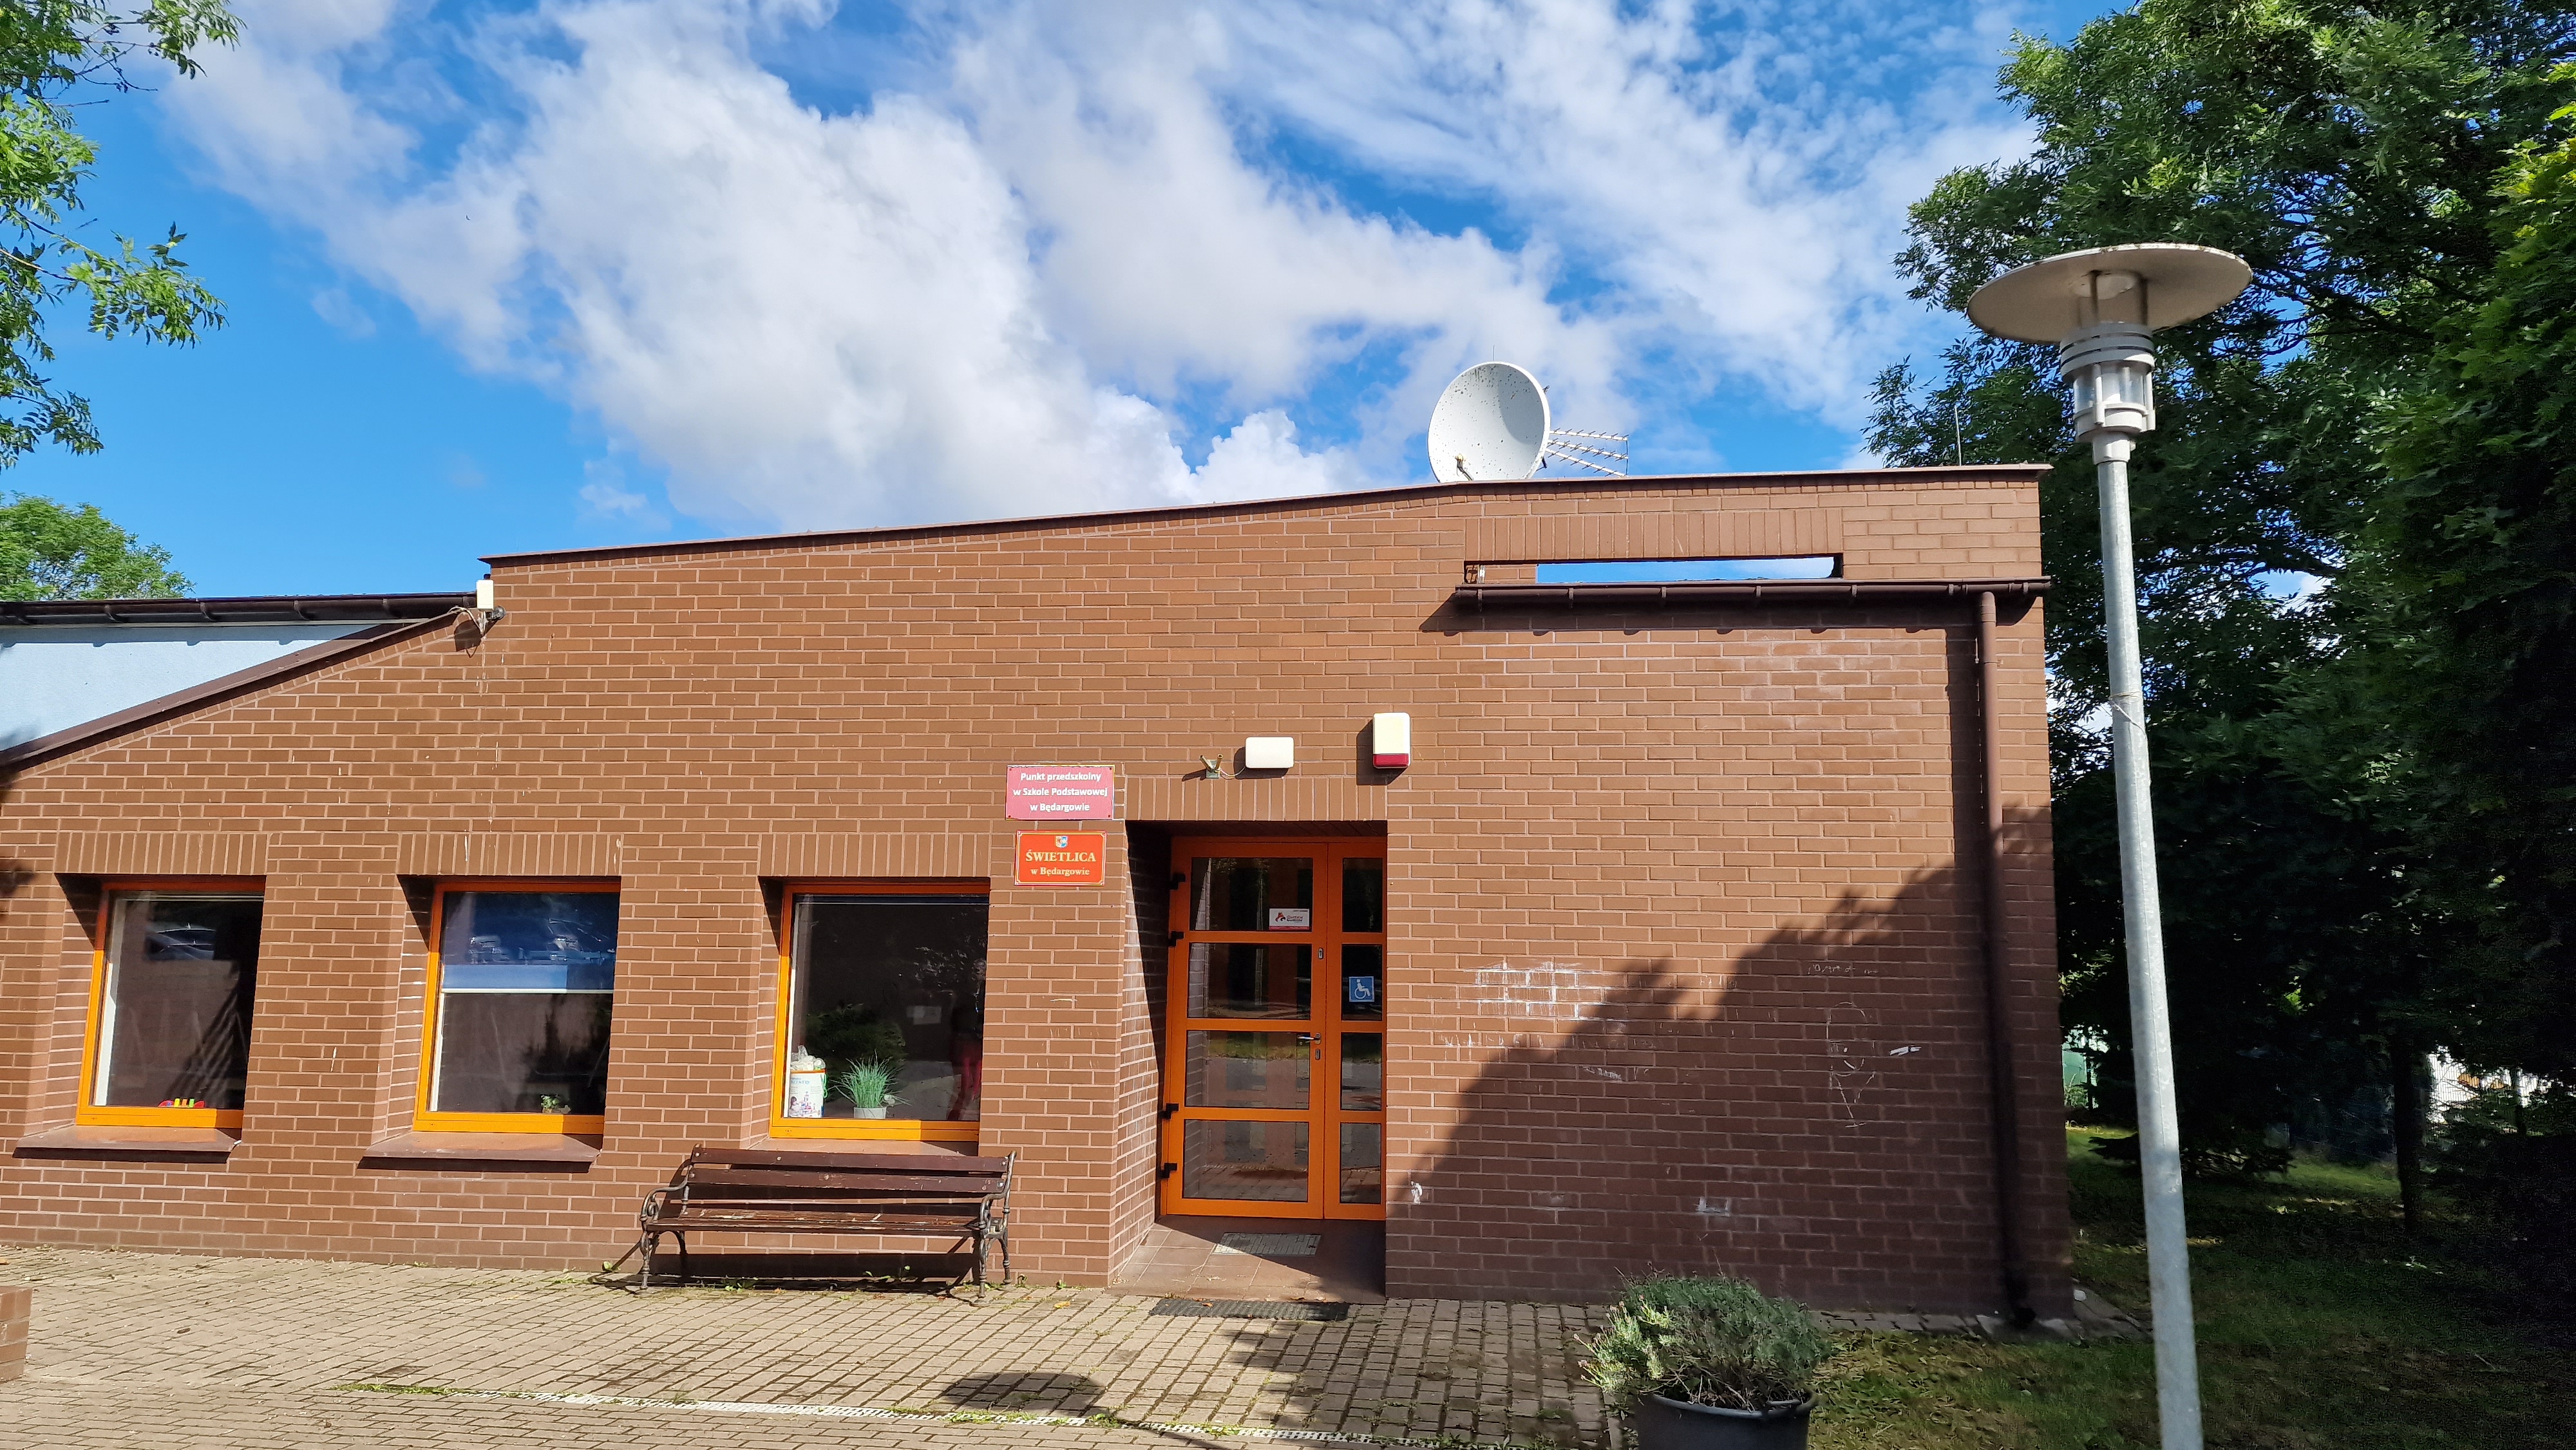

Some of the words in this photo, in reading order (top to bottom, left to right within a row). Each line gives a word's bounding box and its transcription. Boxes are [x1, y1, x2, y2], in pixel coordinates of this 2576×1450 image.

[1047, 772, 1101, 782] przedszkolny
[1023, 787, 1049, 796] Szkole
[1051, 787, 1108, 796] Podstawowej
[1039, 803, 1090, 812] Będargowie
[1025, 849, 1096, 862] ŚWIETLICA
[1040, 867, 1090, 877] Będargowie
